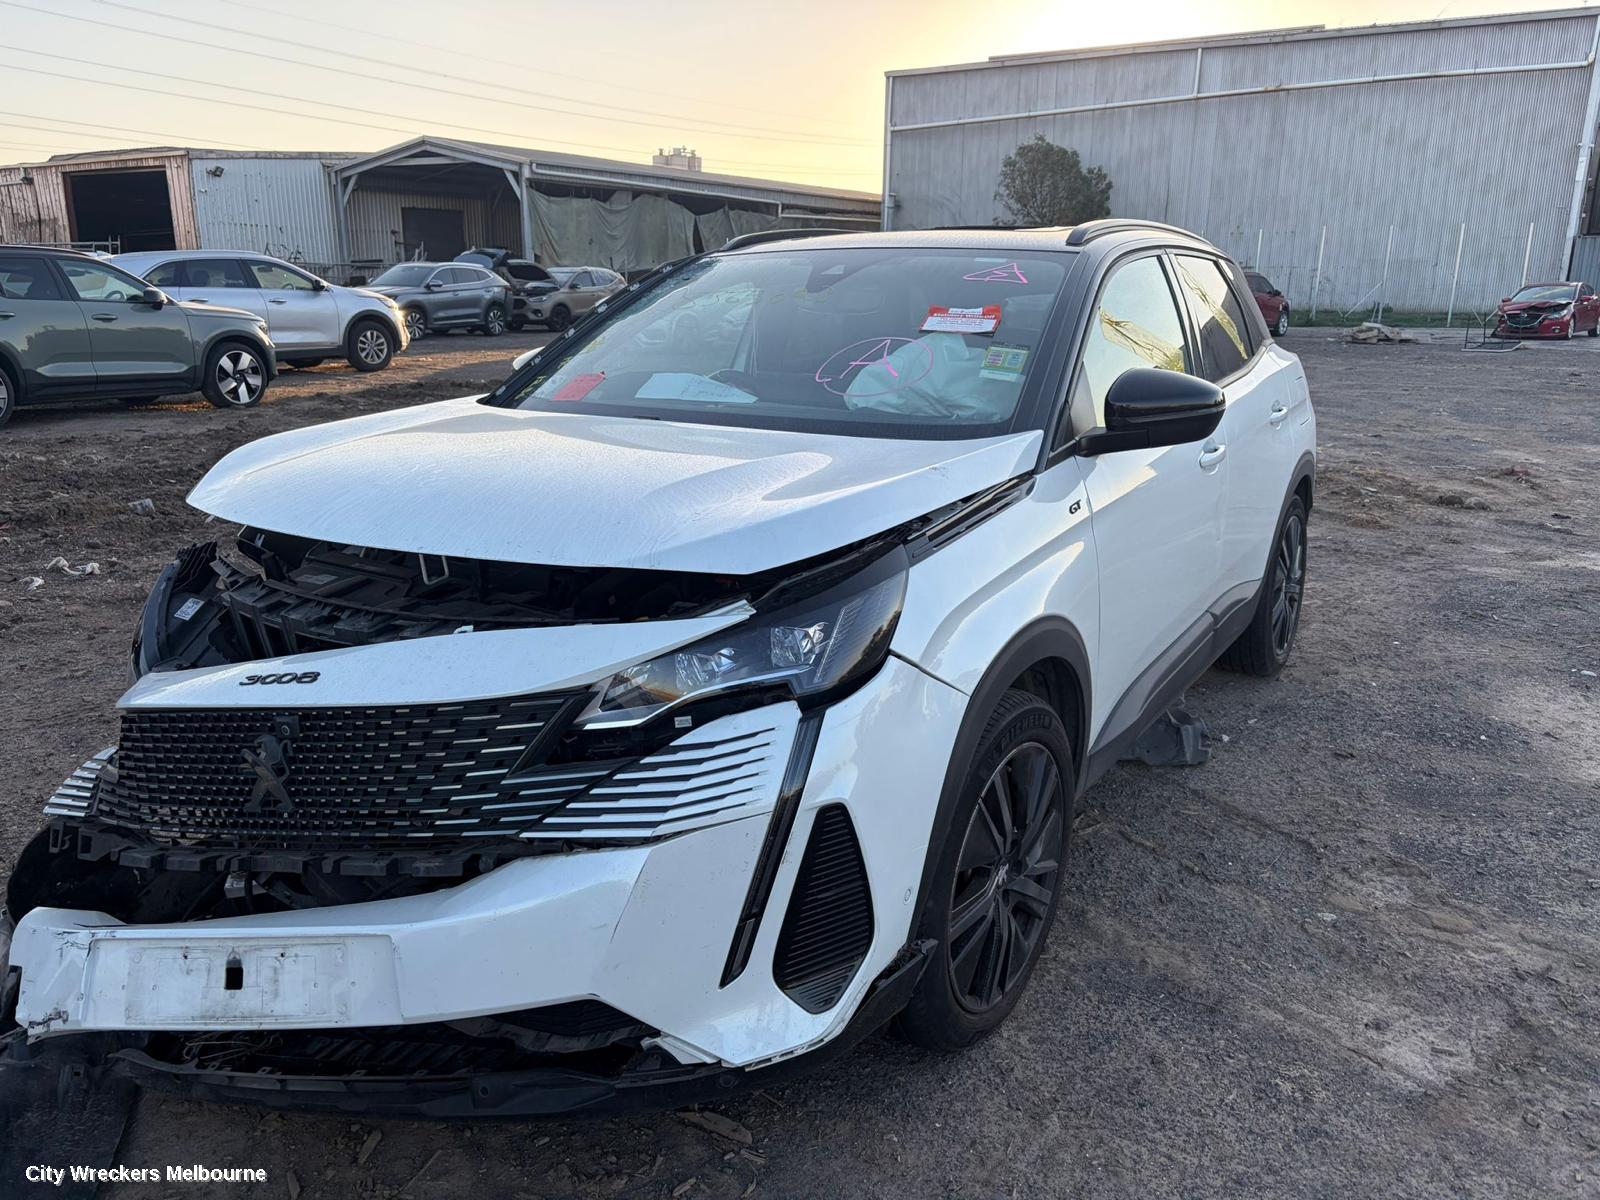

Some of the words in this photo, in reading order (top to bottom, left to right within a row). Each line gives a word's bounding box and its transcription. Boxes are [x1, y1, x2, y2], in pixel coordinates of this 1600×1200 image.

[1069, 499, 1082, 515] GT
[239, 671, 321, 686] 3008
[1000, 712, 1053, 752] MICHELIN
